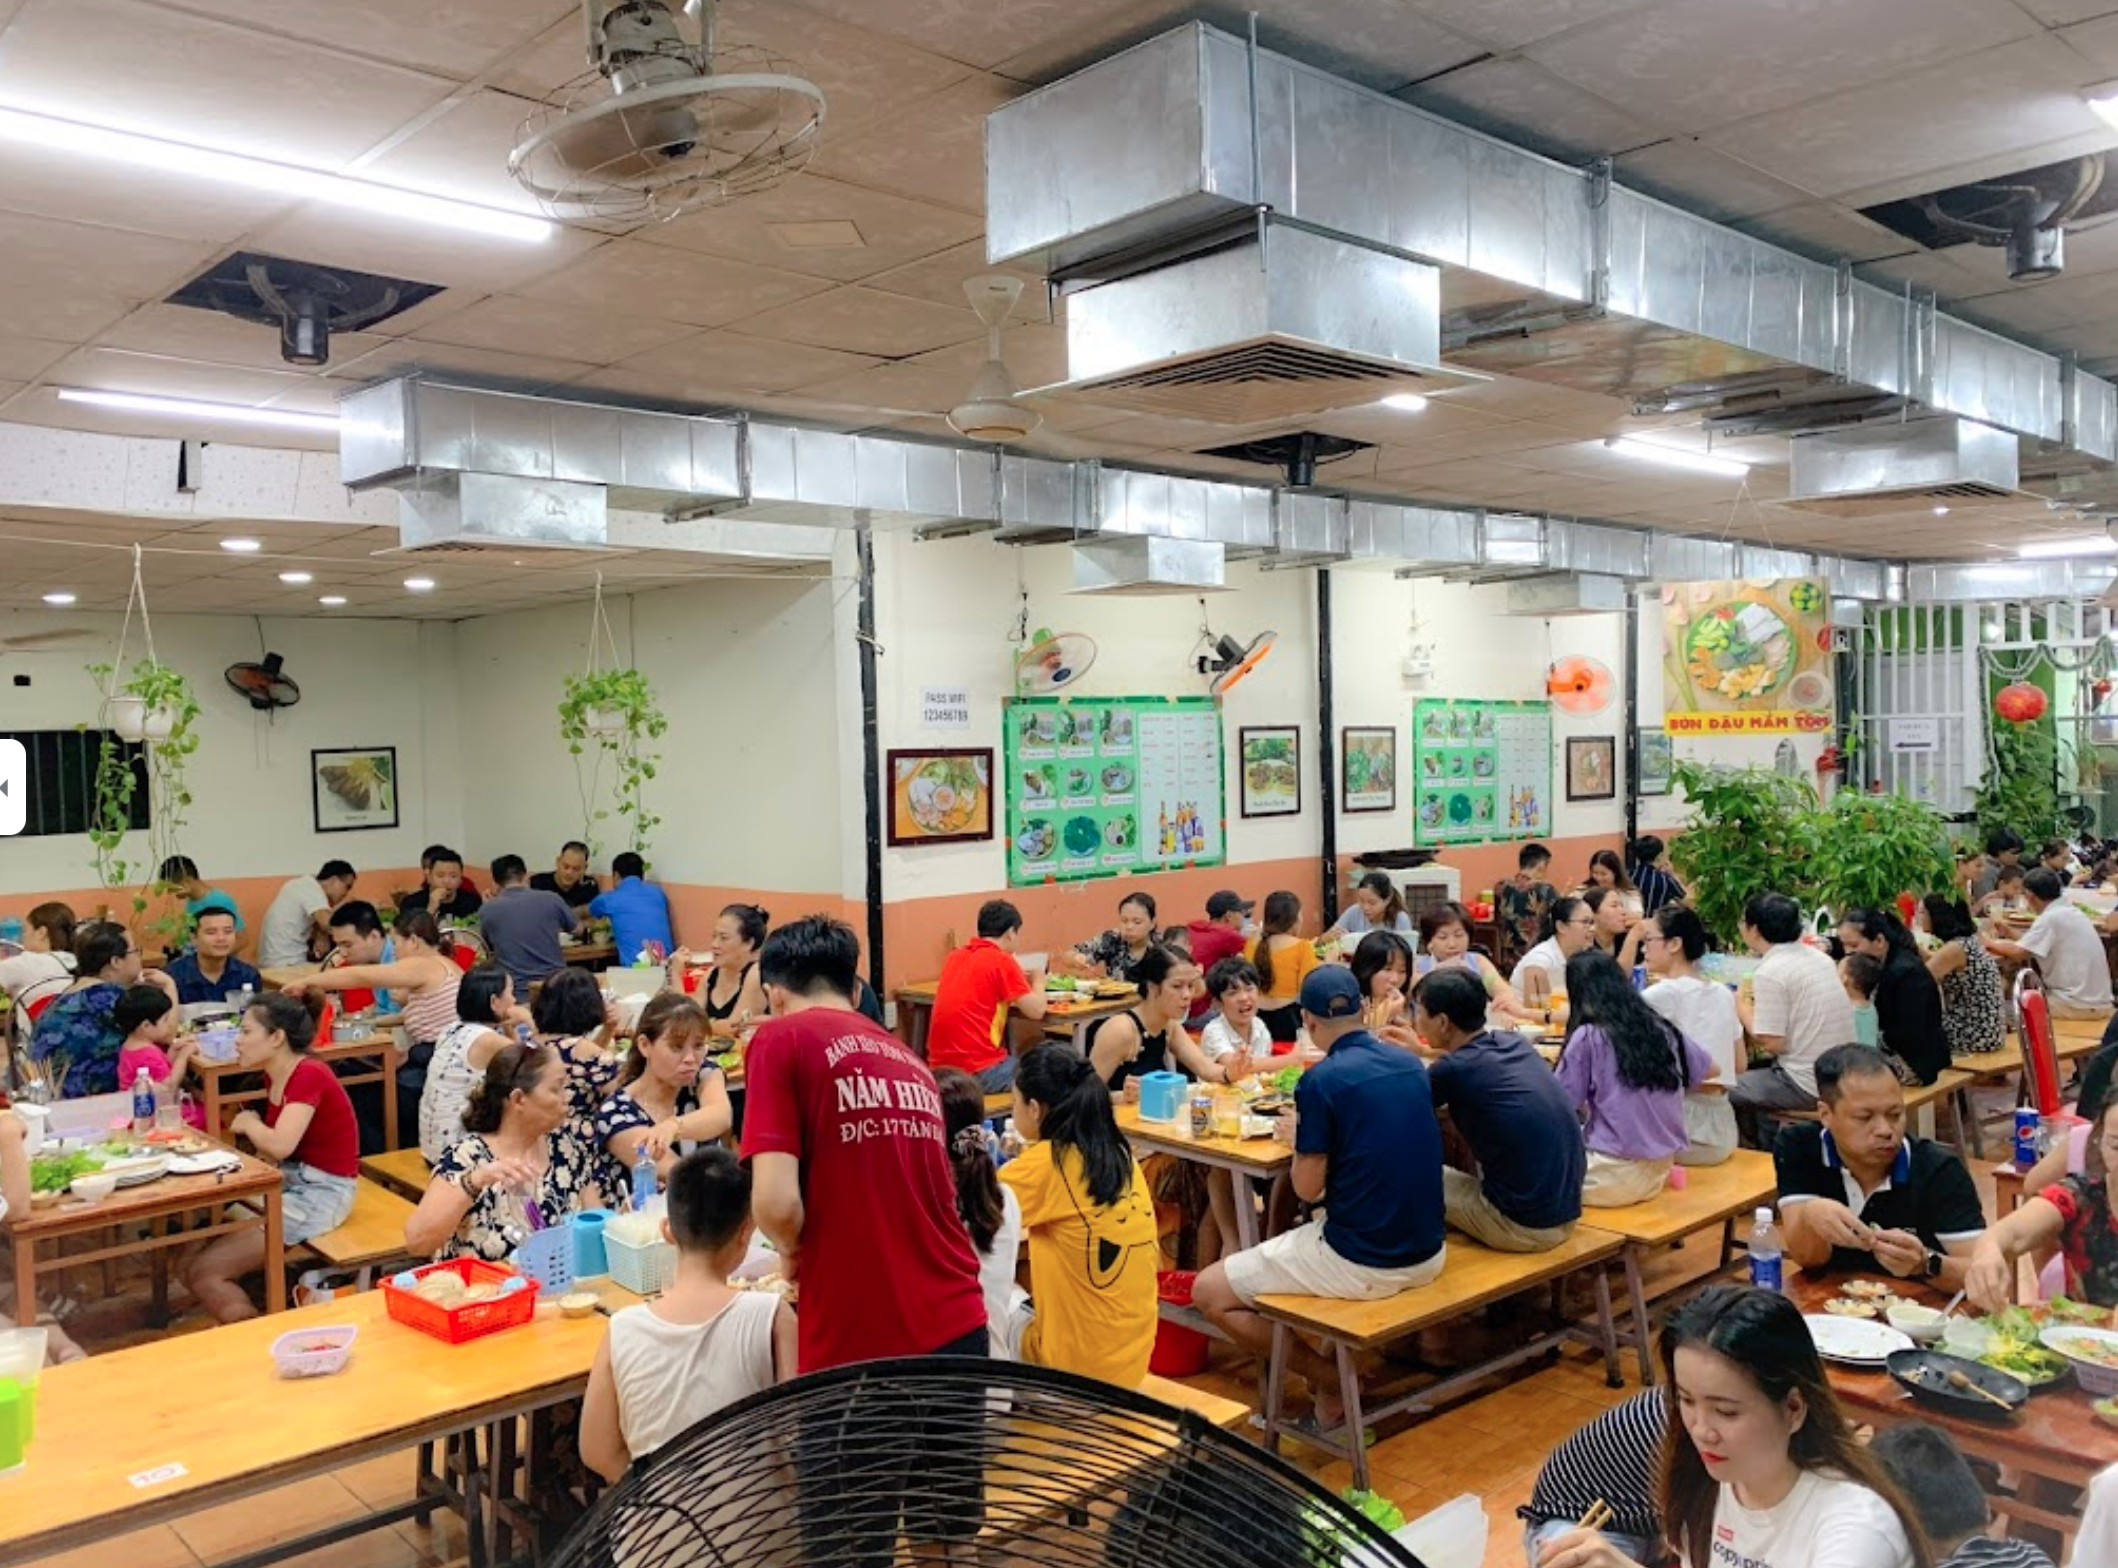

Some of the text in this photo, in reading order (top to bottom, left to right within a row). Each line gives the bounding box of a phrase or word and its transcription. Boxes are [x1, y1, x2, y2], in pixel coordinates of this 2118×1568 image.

[925, 692, 966, 704] PASS WIFI
[924, 708, 968, 722] 123456789
[834, 1067, 893, 1113] NĂM
[840, 1118, 880, 1143] Đ/C:
